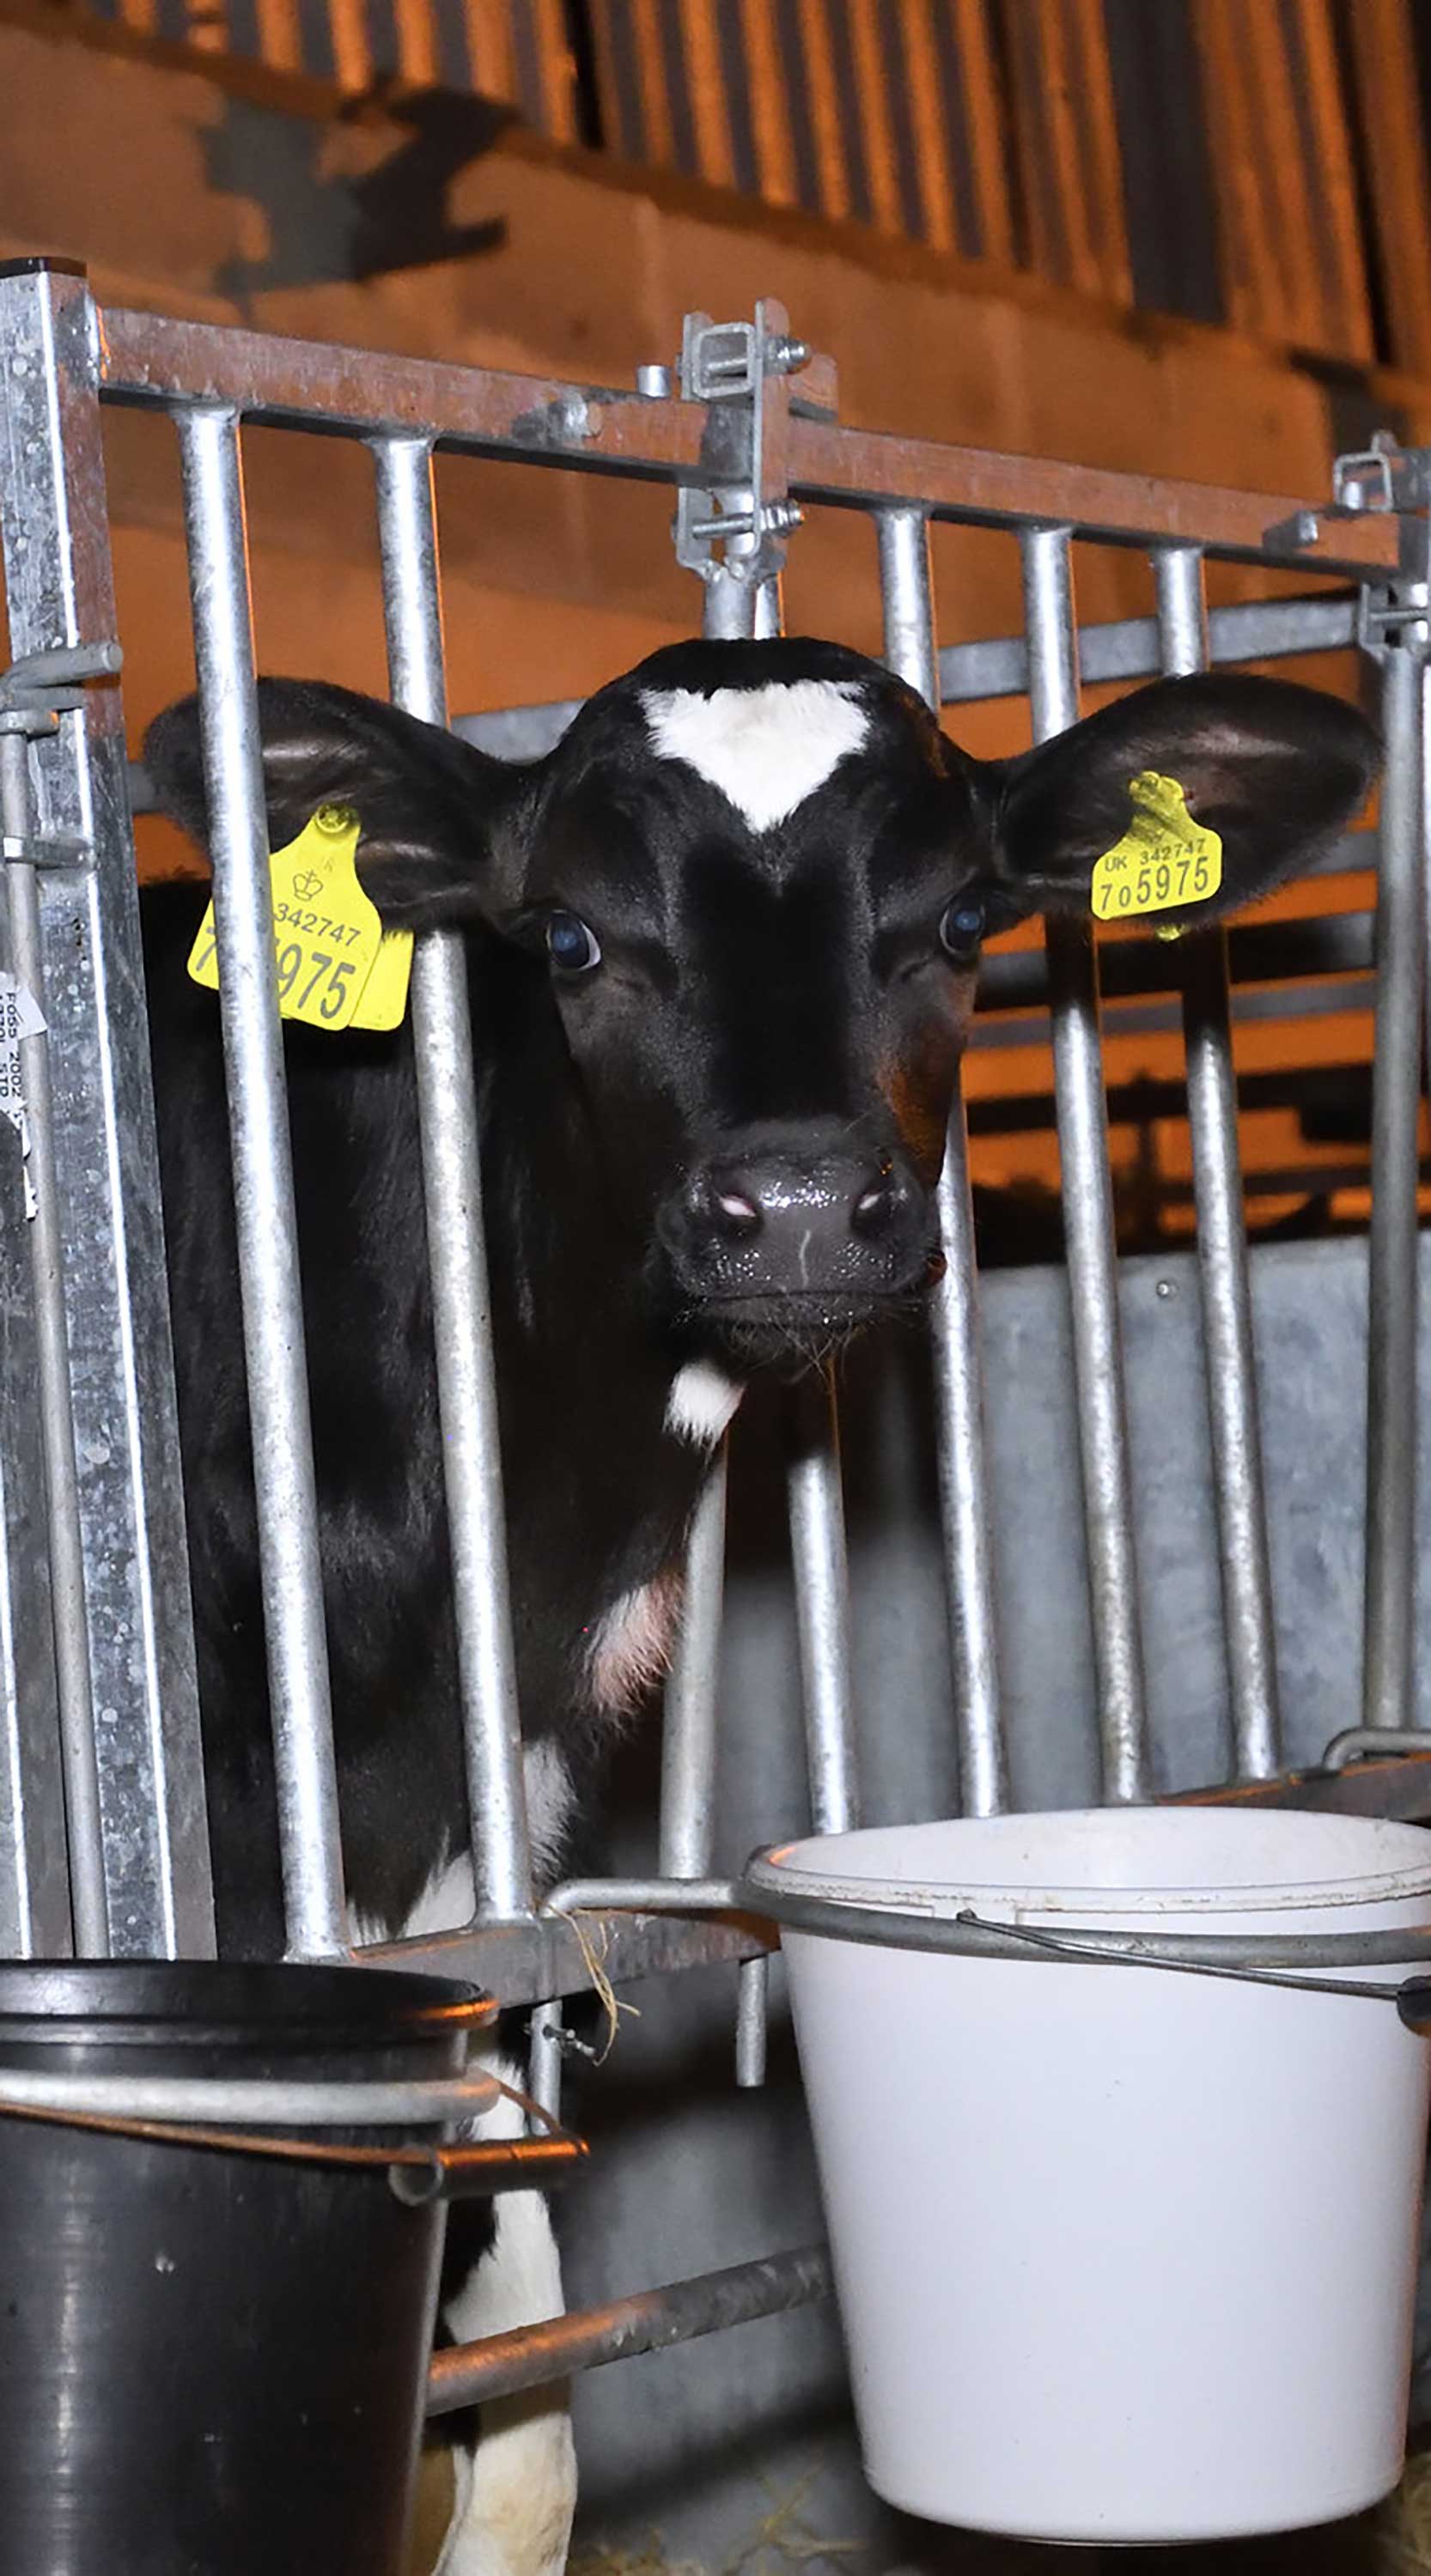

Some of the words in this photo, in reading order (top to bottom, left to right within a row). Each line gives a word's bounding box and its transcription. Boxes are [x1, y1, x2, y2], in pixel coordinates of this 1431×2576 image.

[1105, 855, 1128, 872] UK
[1140, 838, 1206, 866] 342747
[274, 902, 362, 947] 342747
[9, 1052, 21, 1097] 2002
